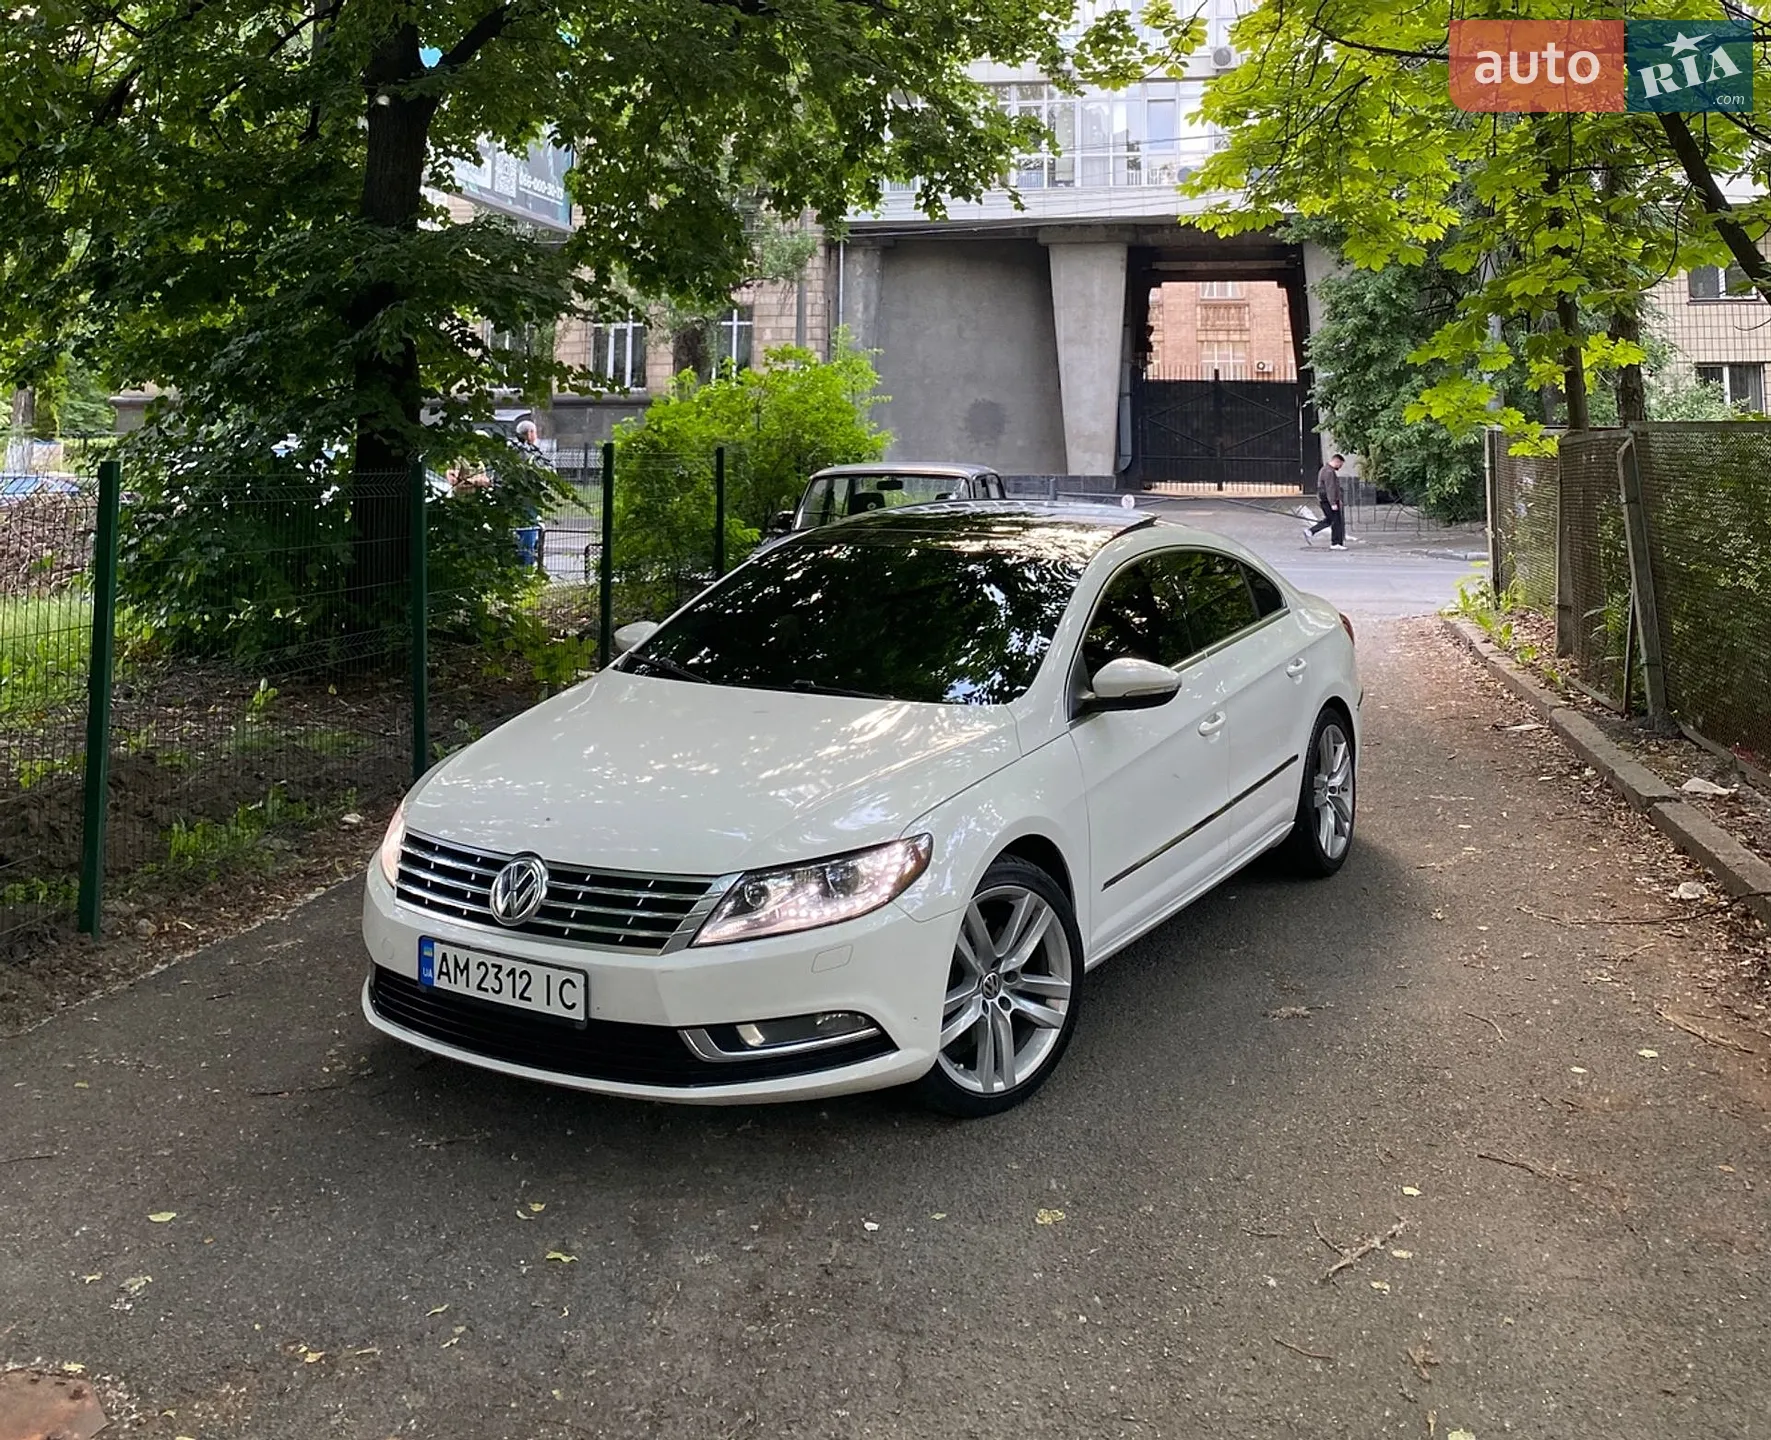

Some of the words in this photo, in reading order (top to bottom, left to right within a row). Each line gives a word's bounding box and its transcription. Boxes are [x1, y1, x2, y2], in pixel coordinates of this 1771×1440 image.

[422, 967, 433, 978] UA
[437, 952, 470, 988] AM
[476, 961, 532, 1002] 2312
[546, 974, 578, 1011] IC
